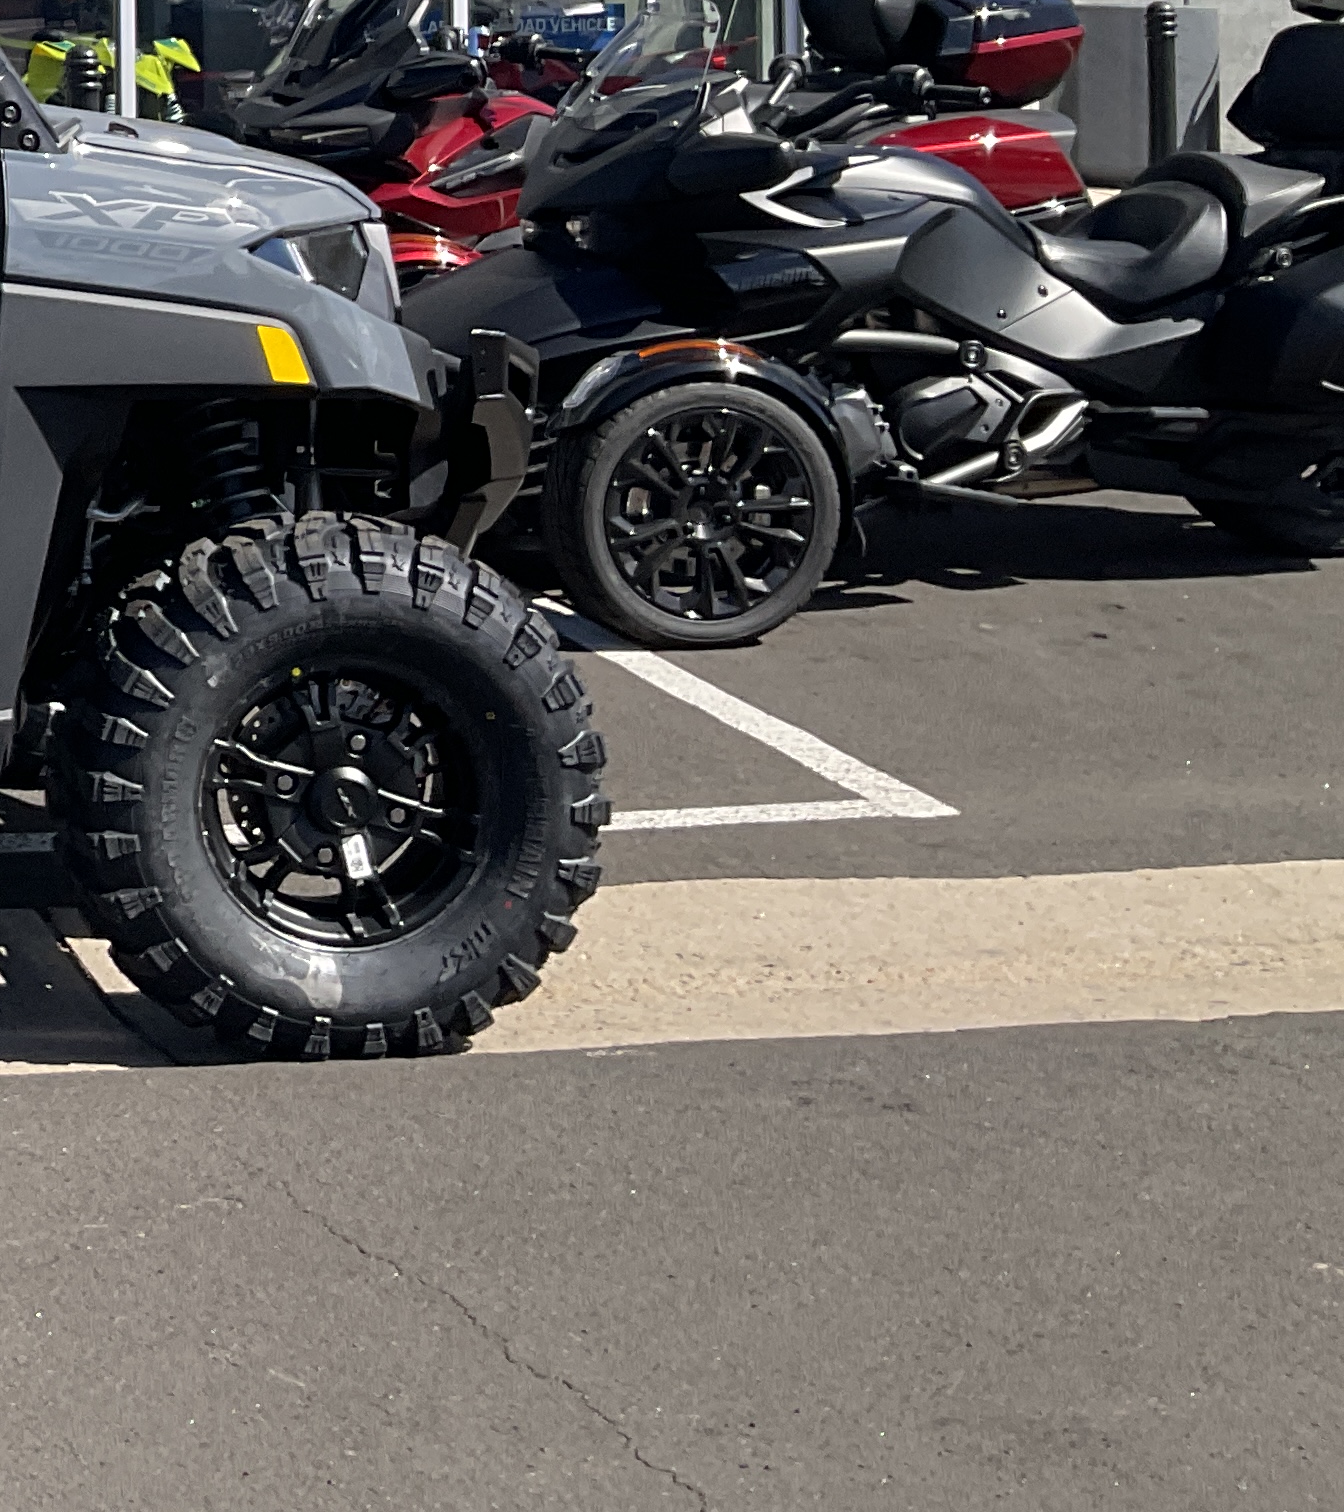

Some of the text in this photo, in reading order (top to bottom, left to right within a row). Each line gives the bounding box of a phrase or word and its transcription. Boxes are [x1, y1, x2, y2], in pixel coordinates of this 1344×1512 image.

[549, 16, 617, 35] VEHICLE
[37, 190, 234, 231] XP
[51, 230, 192, 263] 1000
